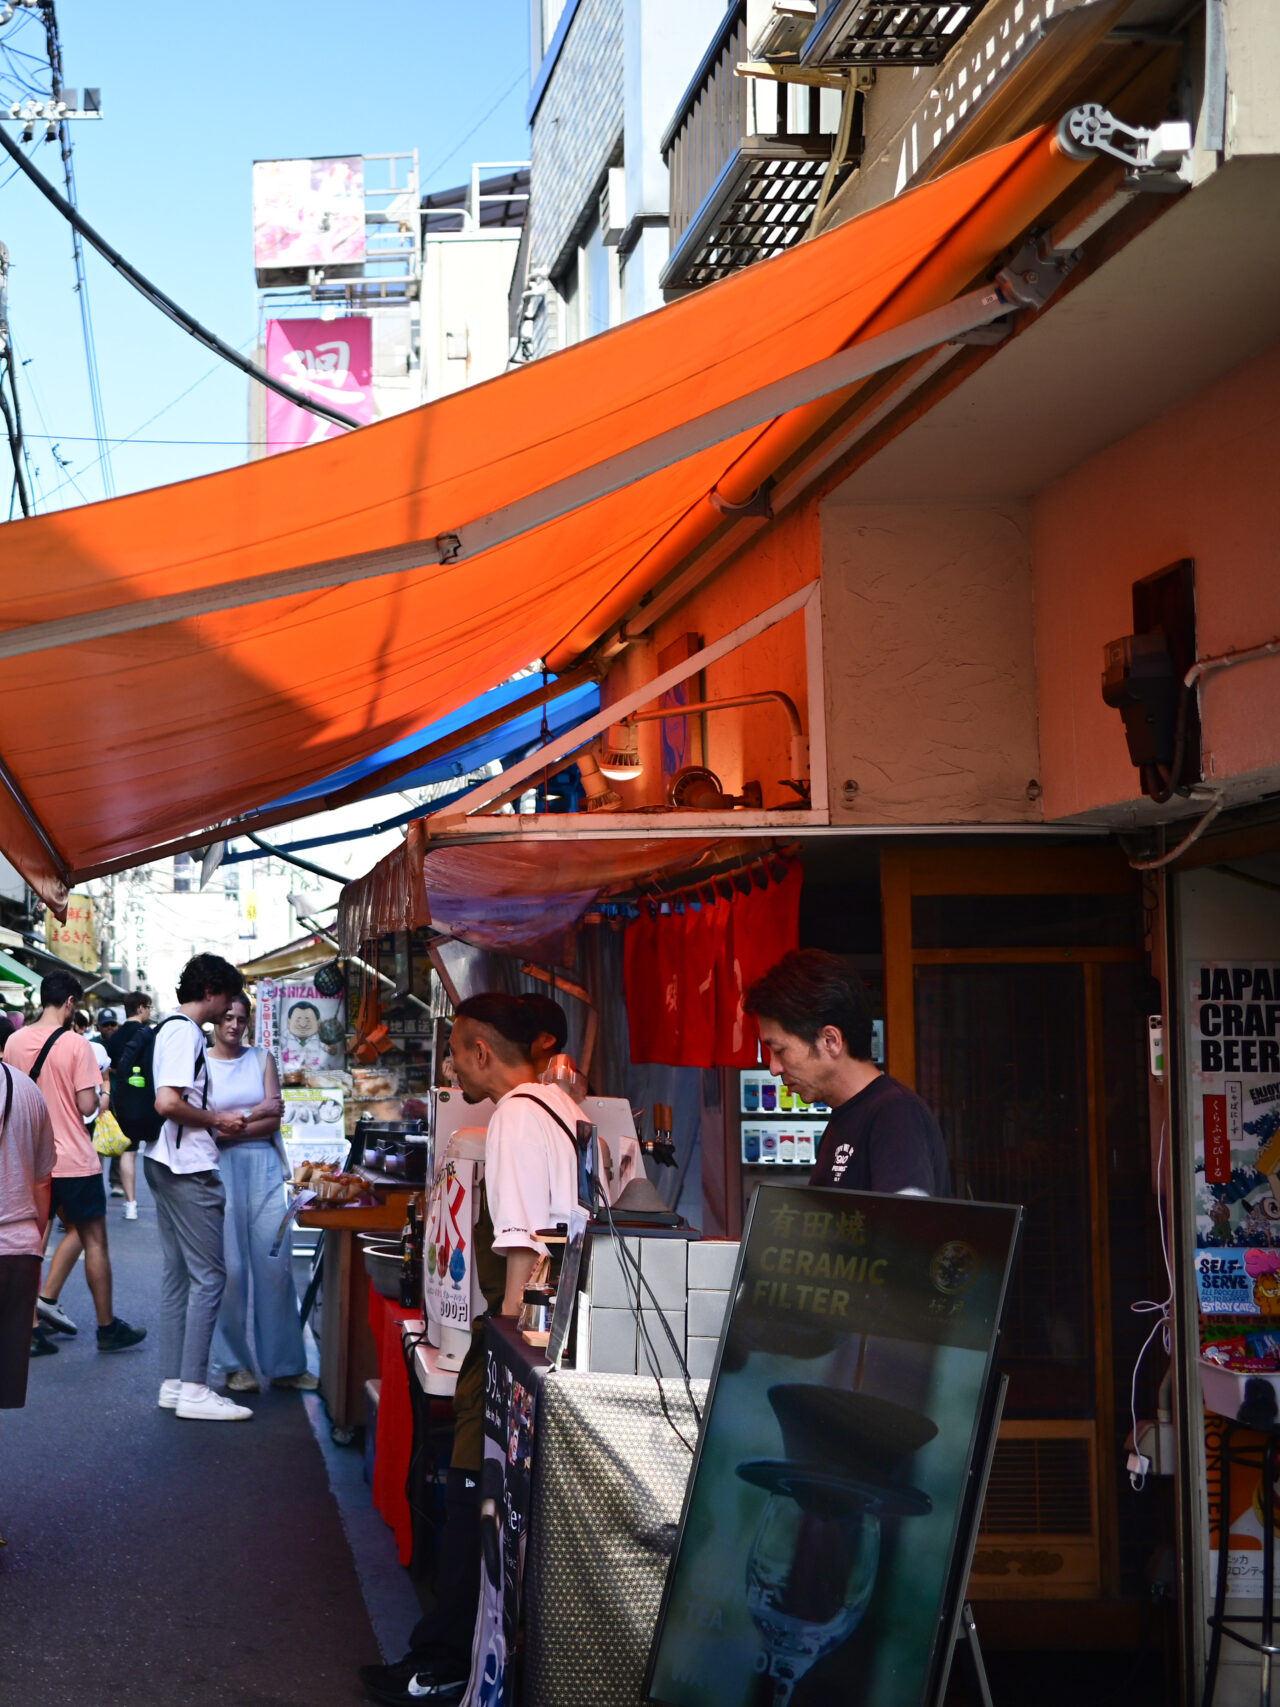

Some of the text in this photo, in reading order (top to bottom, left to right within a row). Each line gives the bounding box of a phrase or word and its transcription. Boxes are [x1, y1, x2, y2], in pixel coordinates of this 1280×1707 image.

[1200, 1039, 1280, 1072] BEER
[1212, 1101, 1224, 1177] くらふとびーる
[770, 1203, 867, 1246] 有田焼
[760, 1246, 889, 1286] CERAMIC
[1199, 1259, 1244, 1275] SELF-
[1202, 1274, 1249, 1290] SERVE
[752, 1279, 851, 1317] FILTER
[1201, 1302, 1257, 1313] STRAY CATS
[1204, 1414, 1221, 1534] RONTIER
